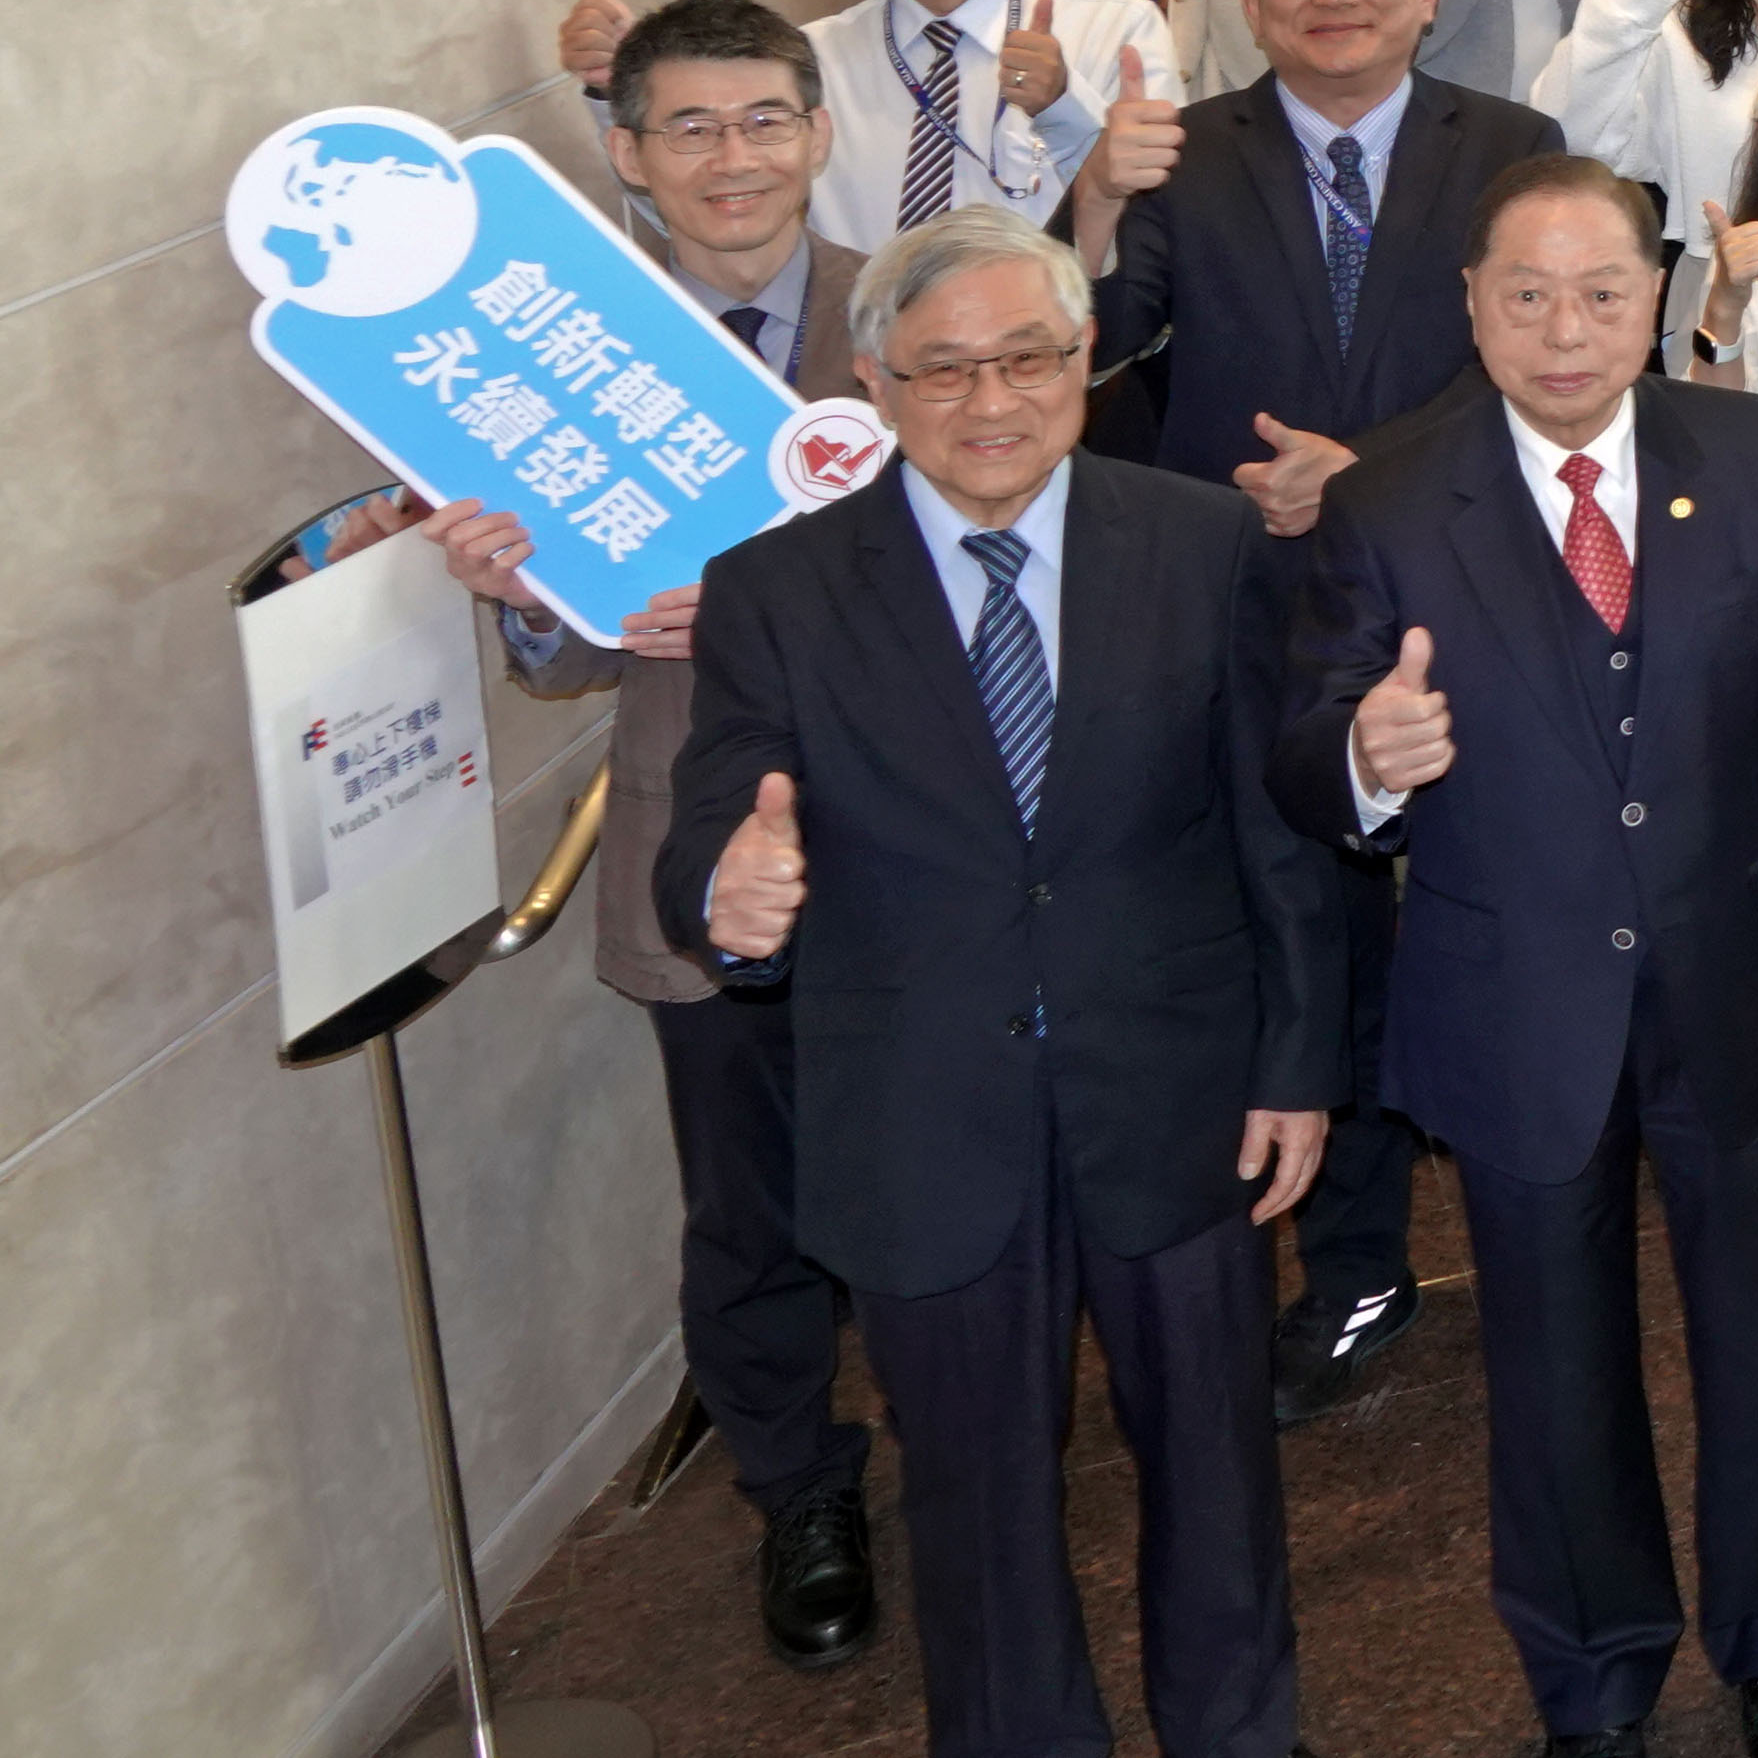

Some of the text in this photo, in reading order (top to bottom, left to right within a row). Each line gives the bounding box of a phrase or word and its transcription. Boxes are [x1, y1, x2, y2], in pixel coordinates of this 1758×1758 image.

[393, 325, 672, 563] 永續發展
[468, 258, 748, 500] 創新轉型
